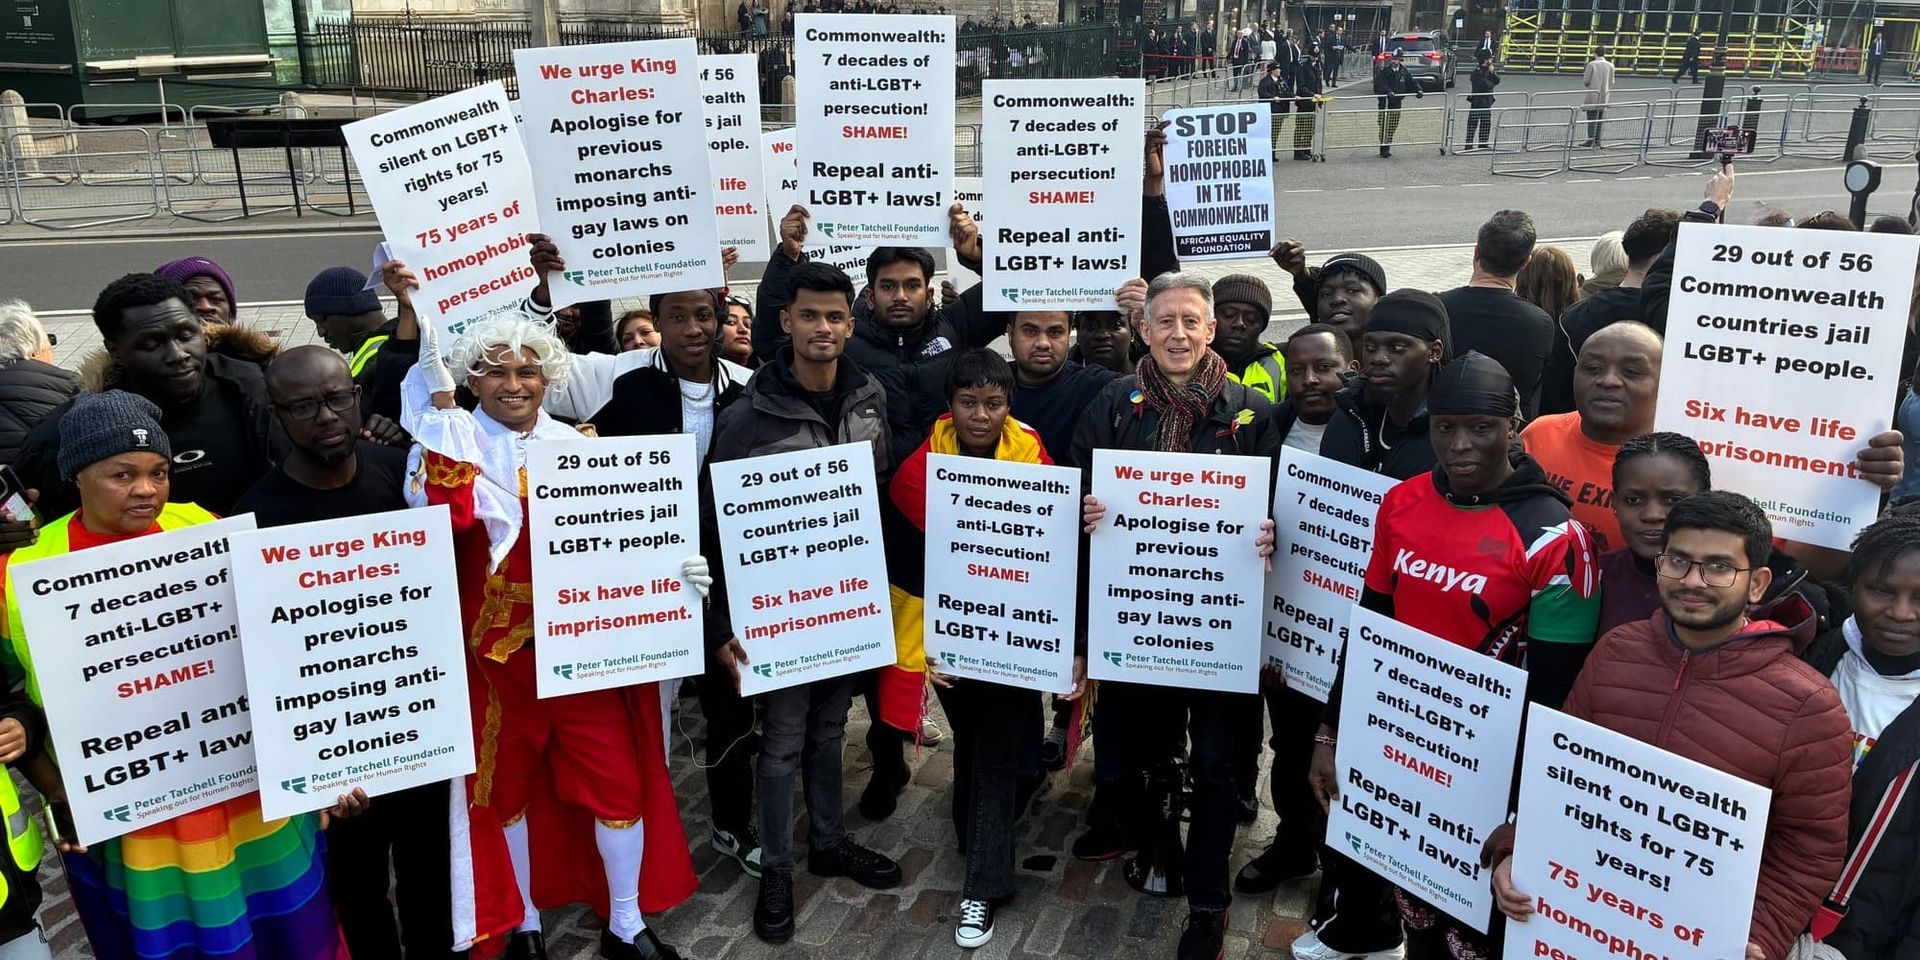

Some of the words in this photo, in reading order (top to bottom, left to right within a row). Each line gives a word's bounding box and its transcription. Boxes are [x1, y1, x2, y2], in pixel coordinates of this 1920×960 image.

[806, 28, 945, 42] Commonwealth:
[539, 64, 571, 79] We
[578, 63, 624, 79] urge
[630, 58, 676, 74] King
[822, 53, 832, 66] 7
[837, 53, 907, 67] decades
[913, 54, 930, 67] of
[714, 68, 734, 80] 56
[829, 78, 921, 90] anti-LGBT+
[571, 86, 654, 104] Charles:
[550, 112, 649, 135] Apologise
[654, 109, 682, 124] for
[716, 114, 741, 130] jail
[824, 102, 927, 116] persecution!
[370, 99, 499, 147] Commonwealth
[842, 125, 907, 138] SHAME!
[1175, 111, 1256, 137] STOP
[378, 148, 427, 173] silent
[431, 143, 452, 156] on
[454, 123, 507, 149] LGBT+
[577, 139, 662, 161] previous
[772, 142, 793, 154] We
[1187, 137, 1247, 158] FOREIGN
[404, 169, 453, 192] rights
[456, 160, 478, 175] for
[481, 150, 502, 166] 75
[574, 162, 672, 183] monarchs
[812, 161, 883, 181] Repeal
[891, 163, 938, 178] anti-
[1169, 158, 1266, 182] HOMOPHOBIA
[438, 181, 488, 211] years!
[720, 178, 746, 190] life
[1196, 184, 1211, 203] IN
[1214, 182, 1241, 202] THE
[556, 191, 646, 212] imposing
[652, 185, 696, 202] anti-
[810, 189, 878, 205] LGBT+
[886, 190, 940, 206] laws!
[416, 228, 441, 248] 75
[445, 212, 497, 242] years
[502, 200, 519, 217] of
[571, 222, 606, 239] gay
[612, 217, 659, 231] laws
[665, 214, 688, 226] on
[894, 224, 939, 232] Foundation
[1173, 203, 1268, 228] COMMONWEALTH
[592, 239, 675, 258] colonies
[1180, 236, 1217, 245] AFRICAN
[1220, 232, 1264, 243] EQUALITY
[1192, 243, 1250, 254] FOUNDATION
[588, 269, 613, 277] Peter
[614, 263, 652, 274] Tatchell
[654, 258, 706, 270] Foundation
[1711, 244, 1742, 262] 29
[1751, 249, 1794, 266] out
[1802, 251, 1831, 269] of
[1838, 252, 1872, 272] 56
[438, 266, 534, 314] persecutio
[1680, 275, 1884, 309] Commonwealth
[1696, 314, 1818, 338] countries
[1824, 323, 1870, 345] jail
[1684, 342, 1766, 365] LGBT+
[1774, 356, 1873, 380] people.
[1685, 400, 1726, 421] Six
[1735, 406, 1800, 432] have
[1810, 417, 1855, 440] life
[557, 454, 580, 470] 29
[587, 453, 618, 468] out
[624, 451, 642, 466] of
[649, 450, 670, 465] 56
[535, 476, 682, 499] Commonwealth
[1114, 466, 1143, 480] We
[1150, 471, 1194, 485] urge
[1201, 470, 1245, 489] King
[1138, 491, 1219, 508] Charles:
[554, 507, 644, 526] countries
[649, 503, 677, 522] jail
[1113, 514, 1210, 534] Apologise
[1216, 520, 1244, 534] for
[1780, 502, 1851, 524] Foundation
[1789, 516, 1815, 528] Rights
[261, 545, 300, 564] We
[309, 539, 364, 557] urge
[372, 530, 425, 548] King
[549, 536, 612, 555] LGBT+
[619, 531, 685, 552] people.
[1136, 541, 1218, 557] previous
[298, 562, 399, 588] Charles:
[1128, 565, 1224, 581] monarchs
[1393, 548, 1488, 594] Kenya
[64, 603, 80, 620] 7
[90, 580, 197, 614] decades
[205, 568, 228, 586] of
[558, 588, 590, 604] Six
[597, 585, 644, 600] have
[651, 578, 681, 594] life
[1108, 583, 1194, 606] imposing
[1200, 593, 1244, 606] anti-
[1302, 570, 1360, 602] SHAME!
[270, 592, 393, 624] Apologise
[399, 585, 432, 602] for
[1273, 595, 1334, 634] Repeal
[84, 601, 222, 647] anti-LGBT+
[548, 605, 691, 637] imprisonment.
[1117, 611, 1151, 626] gay
[1157, 610, 1202, 627] laws
[1208, 618, 1231, 629] on
[304, 619, 407, 651] previous
[1133, 634, 1214, 651] colonies
[83, 624, 238, 682] persecution!
[299, 644, 418, 678] monarchs
[1360, 625, 1511, 699] Commonwealth:
[117, 659, 214, 698] SHAME!
[275, 679, 386, 711] imposing
[394, 665, 445, 688] anti-
[1373, 658, 1383, 672] 7
[1388, 666, 1463, 708] decades
[1469, 703, 1489, 718] of
[293, 717, 337, 741] gay
[344, 705, 400, 726] laws
[408, 698, 435, 713] on
[1376, 690, 1475, 739] anti-LGBT+
[318, 729, 418, 760] colonies
[1367, 712, 1478, 772] persecution!
[311, 770, 342, 783] Peter
[344, 757, 391, 775] Tatchell
[393, 745, 454, 764] Foundation
[312, 780, 348, 792] Speaking
[349, 777, 361, 785] out
[377, 767, 402, 777] Human
[404, 762, 427, 772] Rights
[1383, 744, 1452, 787] SHAME!
[1553, 732, 1746, 821] Commonwealth
[1348, 767, 1421, 818] Repeal
[1428, 812, 1480, 845] anti-
[1546, 765, 1612, 801] silent
[1617, 795, 1648, 816] on
[1657, 805, 1743, 851] LGBT+
[1342, 794, 1411, 842] LGBT+
[1418, 835, 1480, 880] laws!
[1564, 804, 1632, 842] rights
[1640, 832, 1675, 859] for
[1683, 849, 1714, 876] 75
[1595, 849, 1670, 892] years!
[1548, 860, 1578, 888] 75
[1584, 882, 1663, 928] years
[1674, 924, 1704, 946] of
